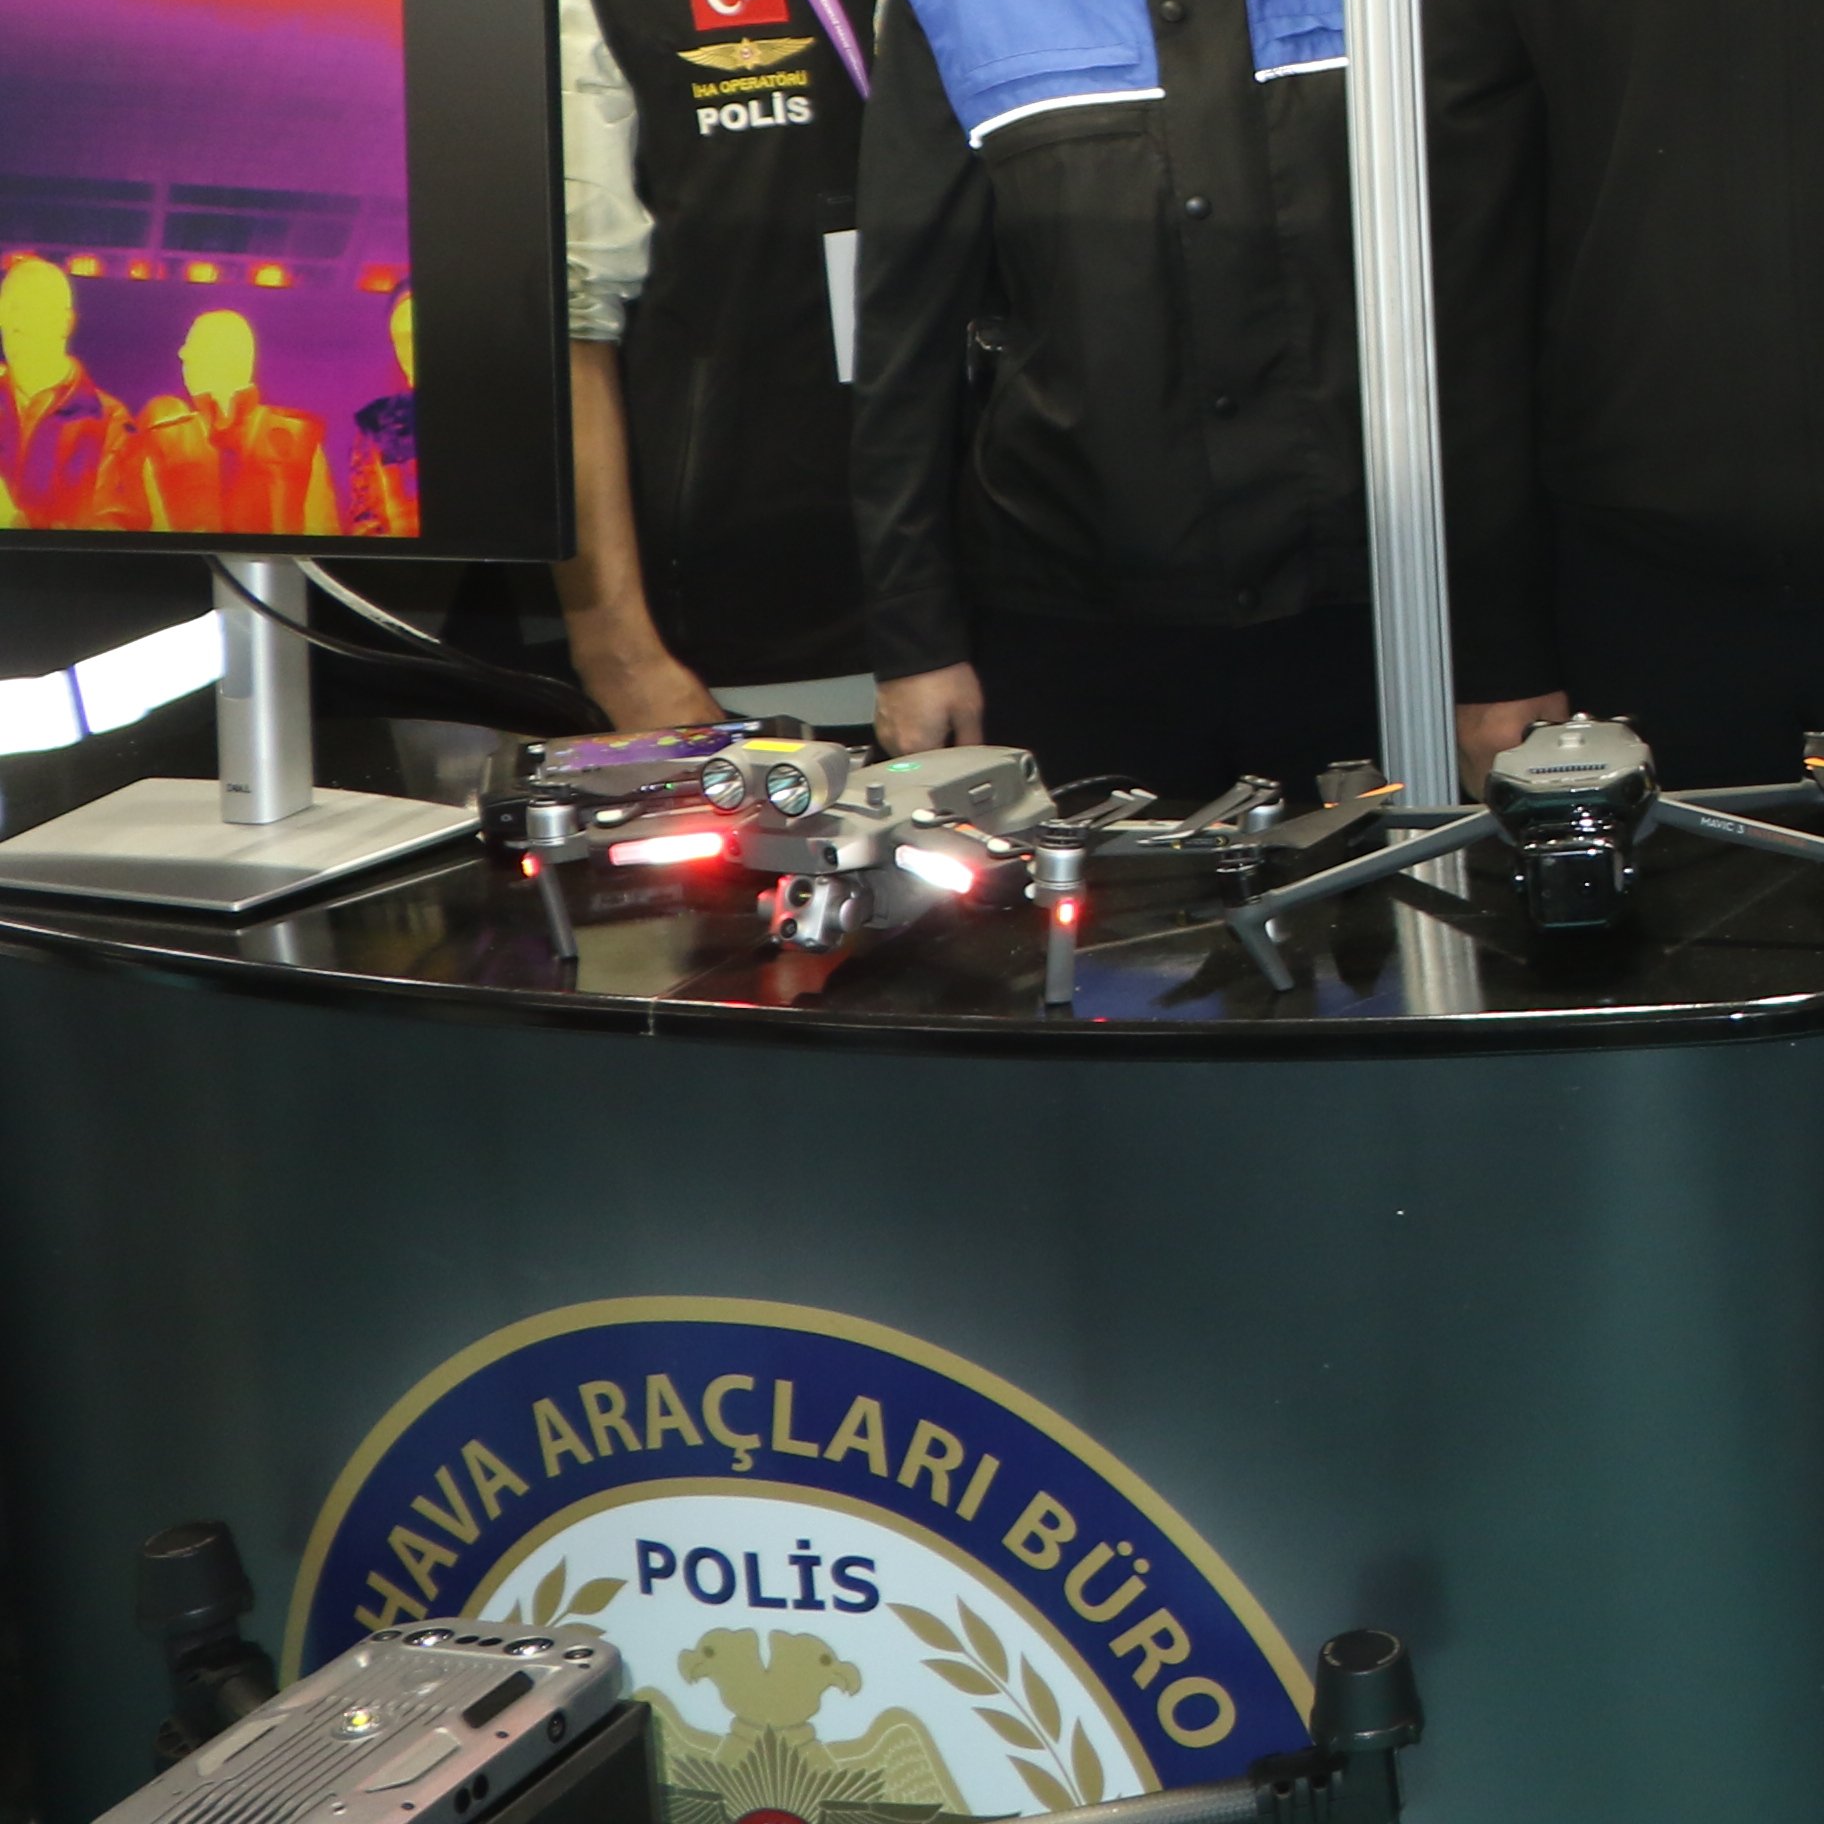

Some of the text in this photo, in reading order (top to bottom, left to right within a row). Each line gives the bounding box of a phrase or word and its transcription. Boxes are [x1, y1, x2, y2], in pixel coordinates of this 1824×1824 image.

[696, 90, 813, 136] POLİS
[353, 1372, 1237, 1750] HAVA ARAÇLARI BÜRO
[634, 1536, 884, 1616] POLİS
